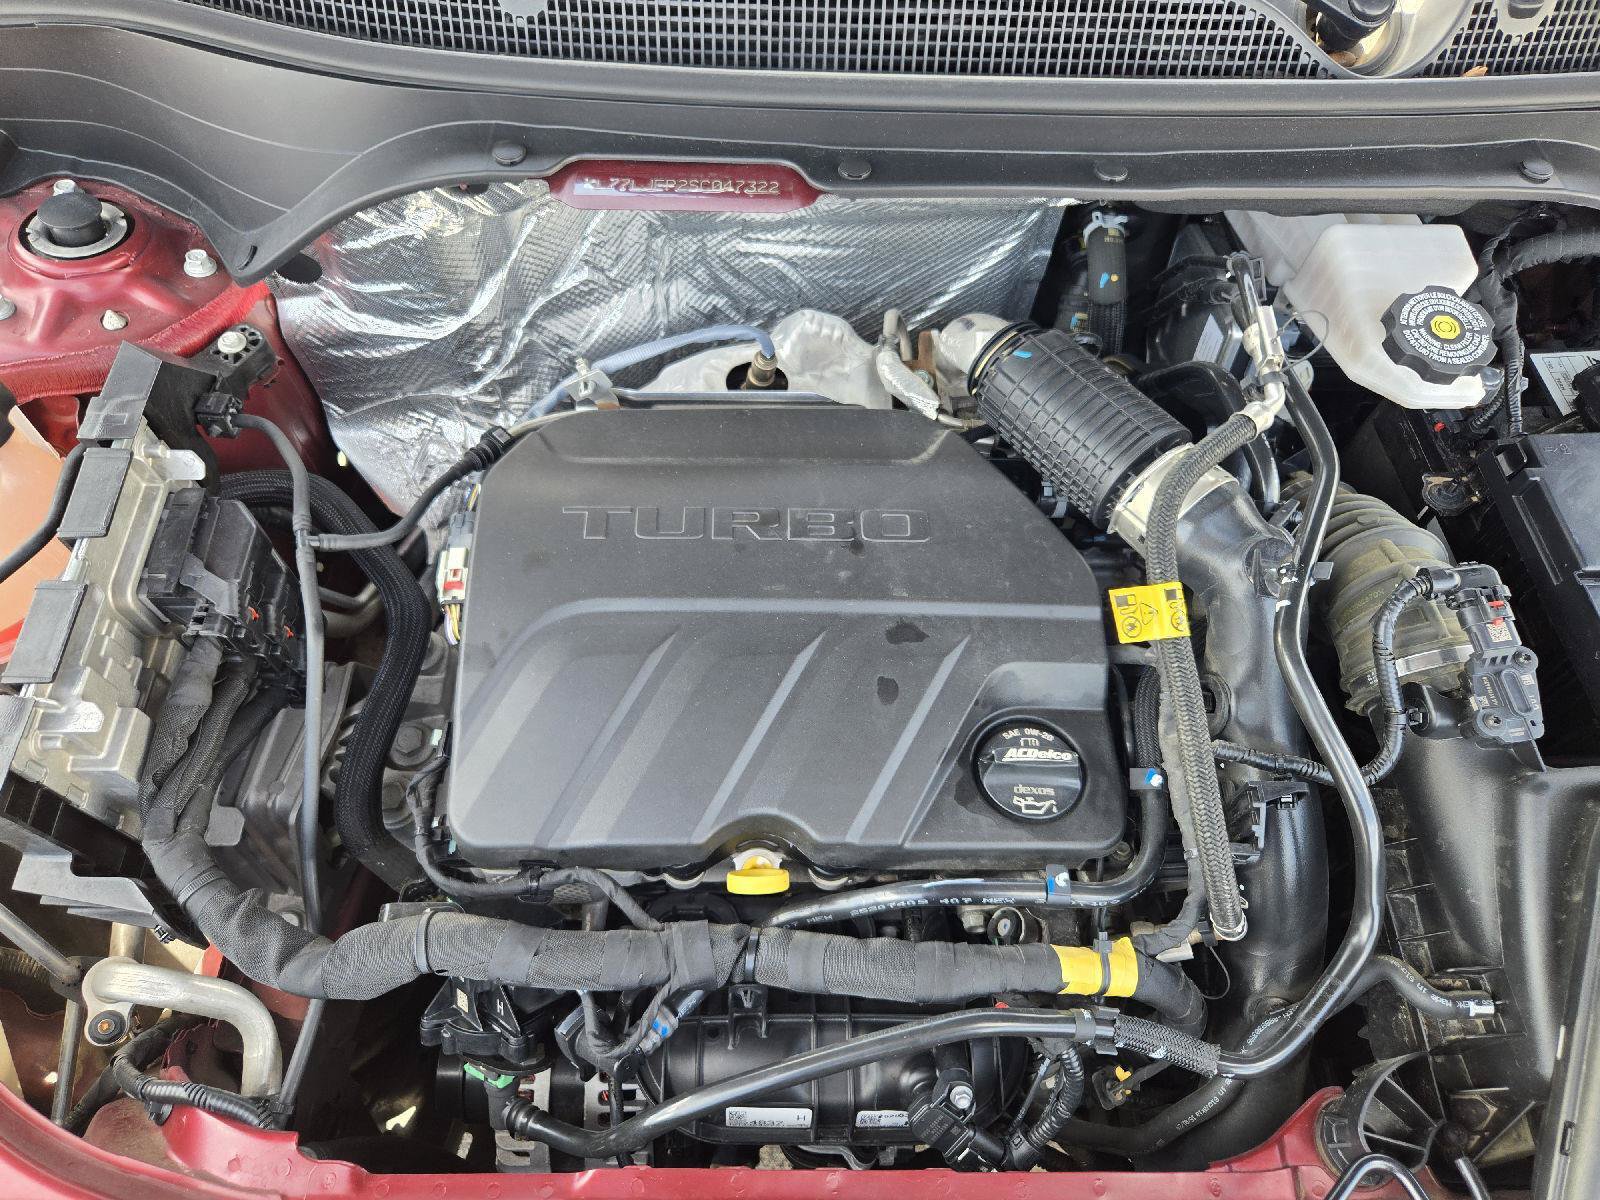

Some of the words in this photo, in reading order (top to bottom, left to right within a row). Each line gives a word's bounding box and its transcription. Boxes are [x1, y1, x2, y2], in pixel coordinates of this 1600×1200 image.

[1437, 292, 1461, 304] BOUCHON
[1418, 338, 1440, 355] BEFORE
[1429, 352, 1447, 363] FROM
[1452, 355, 1475, 365] SEALED
[562, 505, 931, 542] TURBO
[1002, 728, 1021, 740] SAE
[1003, 747, 1072, 761] ACDelco
[1013, 784, 1055, 796] dexos
